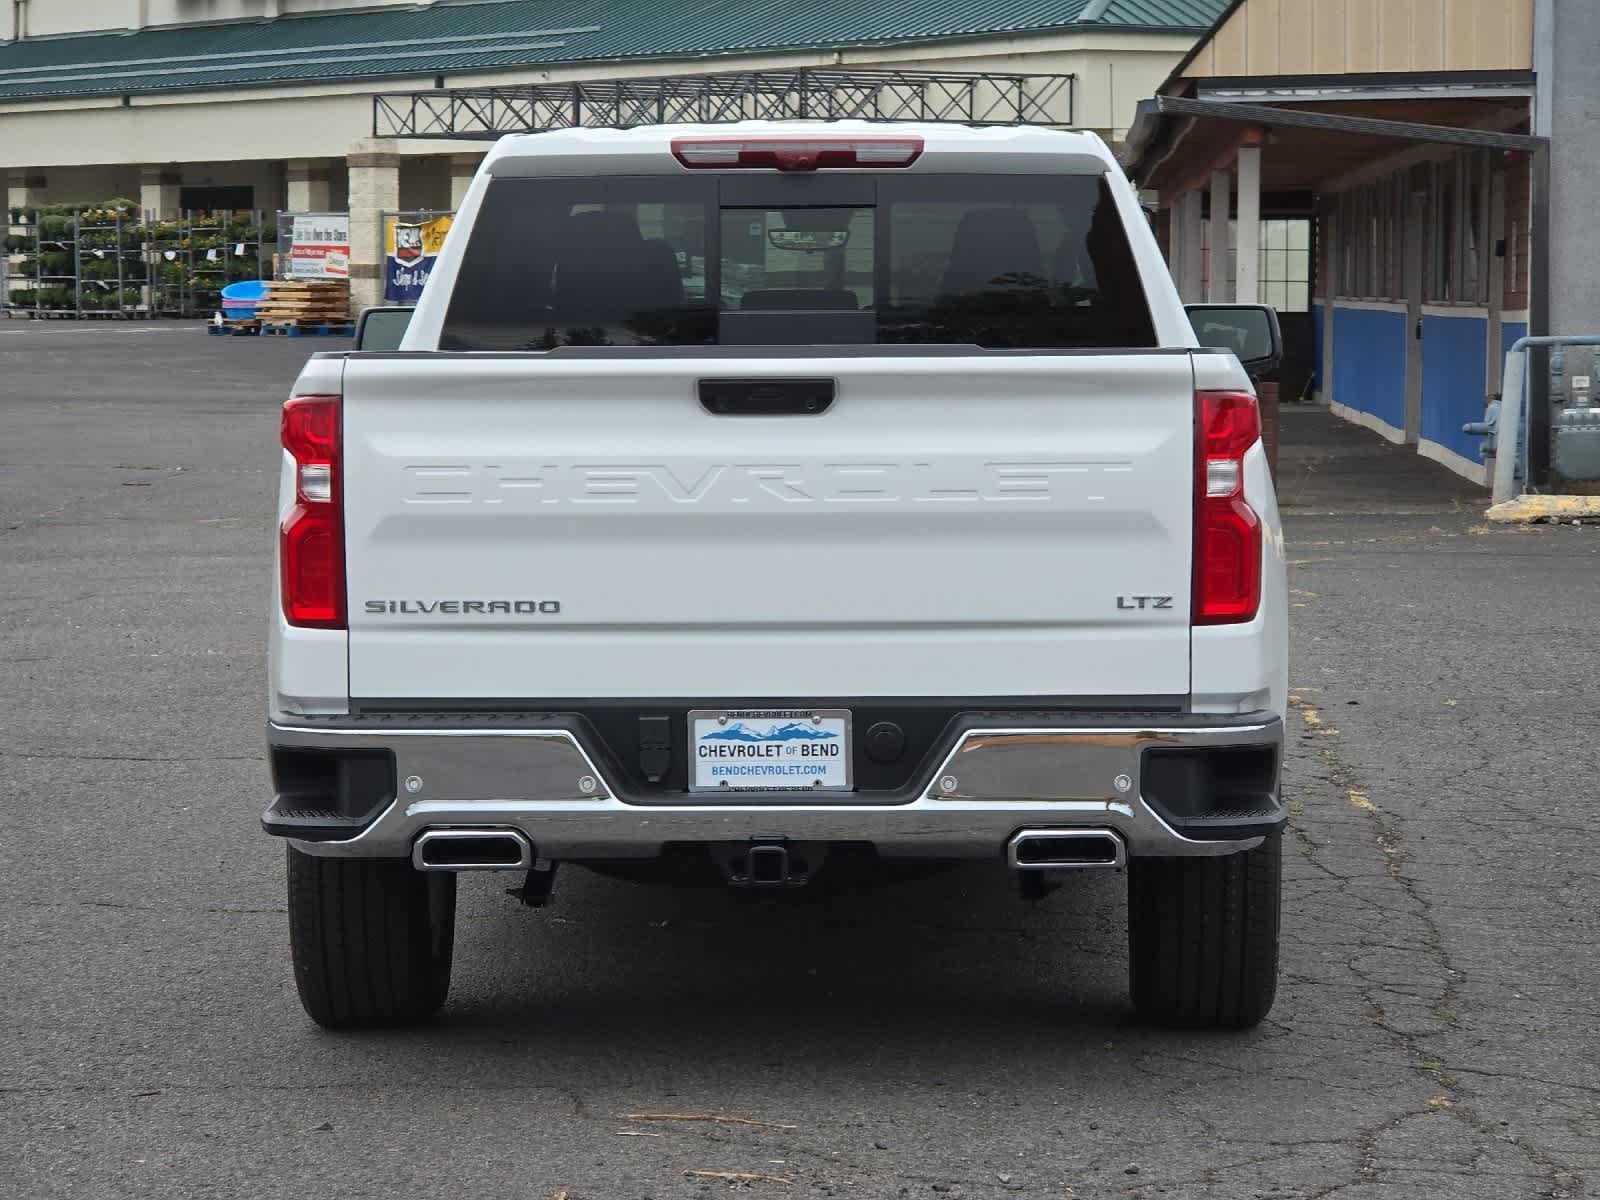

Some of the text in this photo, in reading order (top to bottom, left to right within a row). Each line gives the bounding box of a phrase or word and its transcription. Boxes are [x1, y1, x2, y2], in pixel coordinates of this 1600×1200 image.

[402, 462, 1132, 503] CHEVROLET
[365, 600, 561, 614] SILVERADO
[1116, 596, 1173, 609] LTZ
[698, 744, 839, 758] CHEVROLET OF BEND
[711, 765, 826, 776] BENDCHEVROLET.COM
